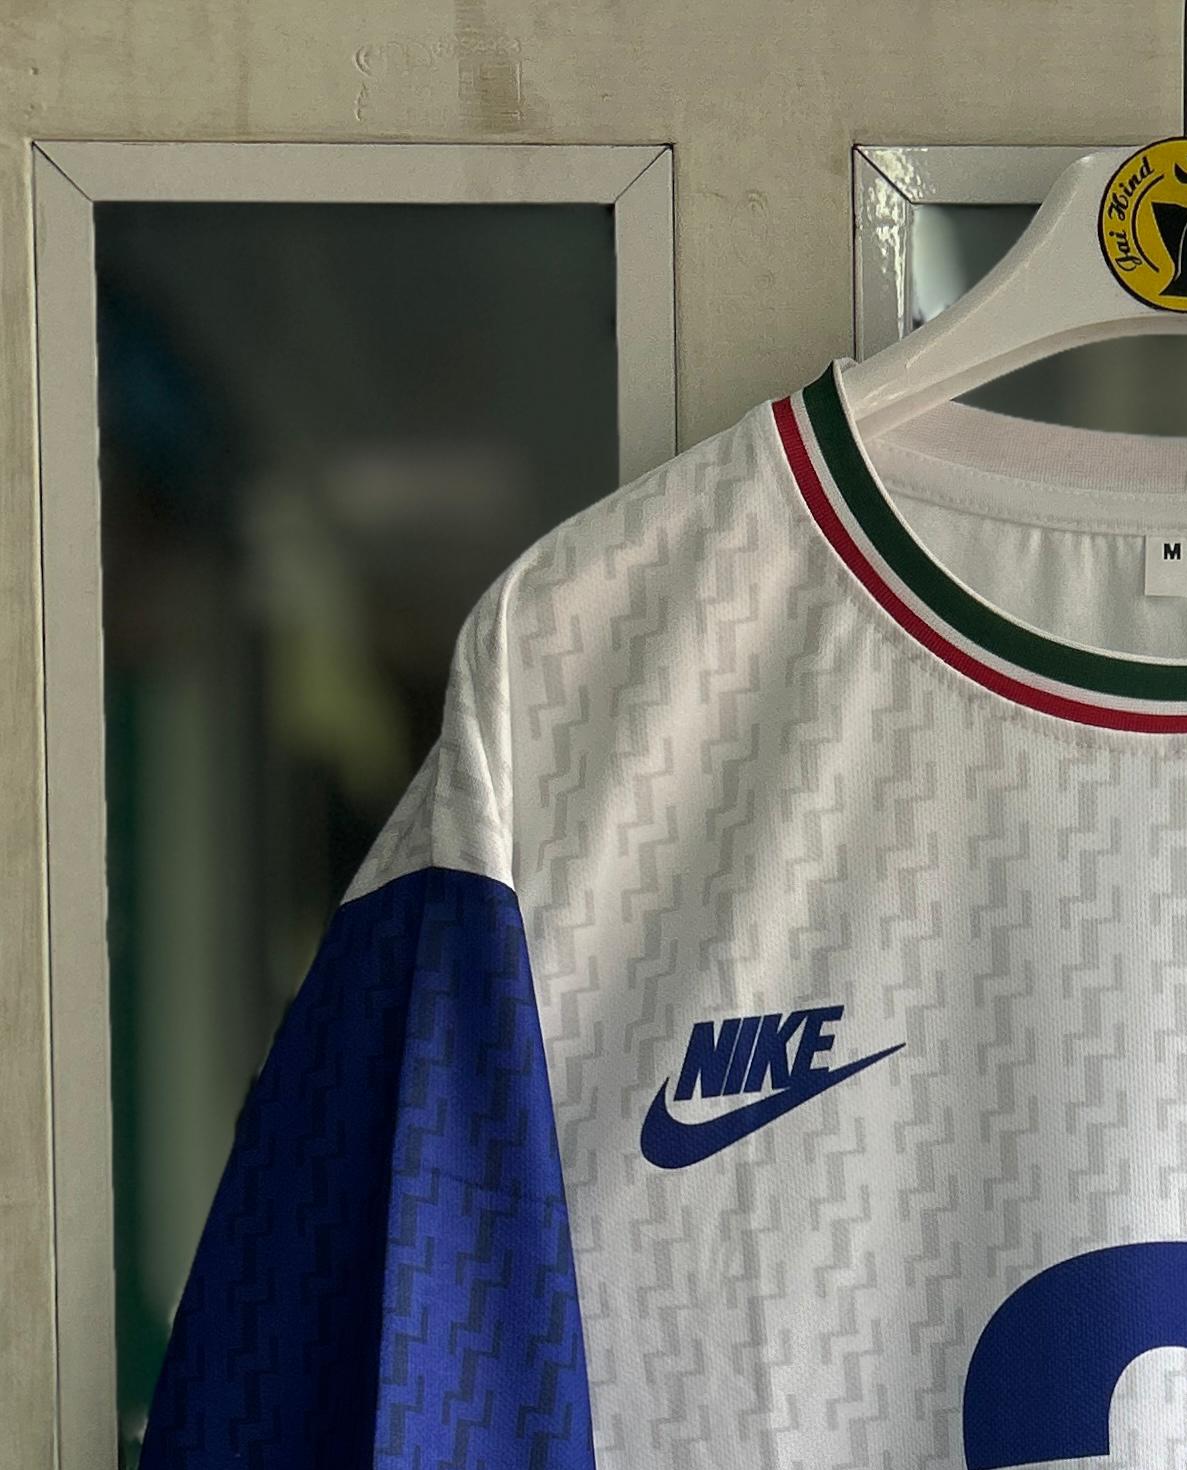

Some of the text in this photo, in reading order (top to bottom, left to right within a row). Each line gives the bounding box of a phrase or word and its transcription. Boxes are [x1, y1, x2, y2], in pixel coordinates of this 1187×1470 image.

[1107, 156, 1155, 221] Hind
[1163, 543, 1181, 560] M
[673, 1005, 844, 1101] NIKE
